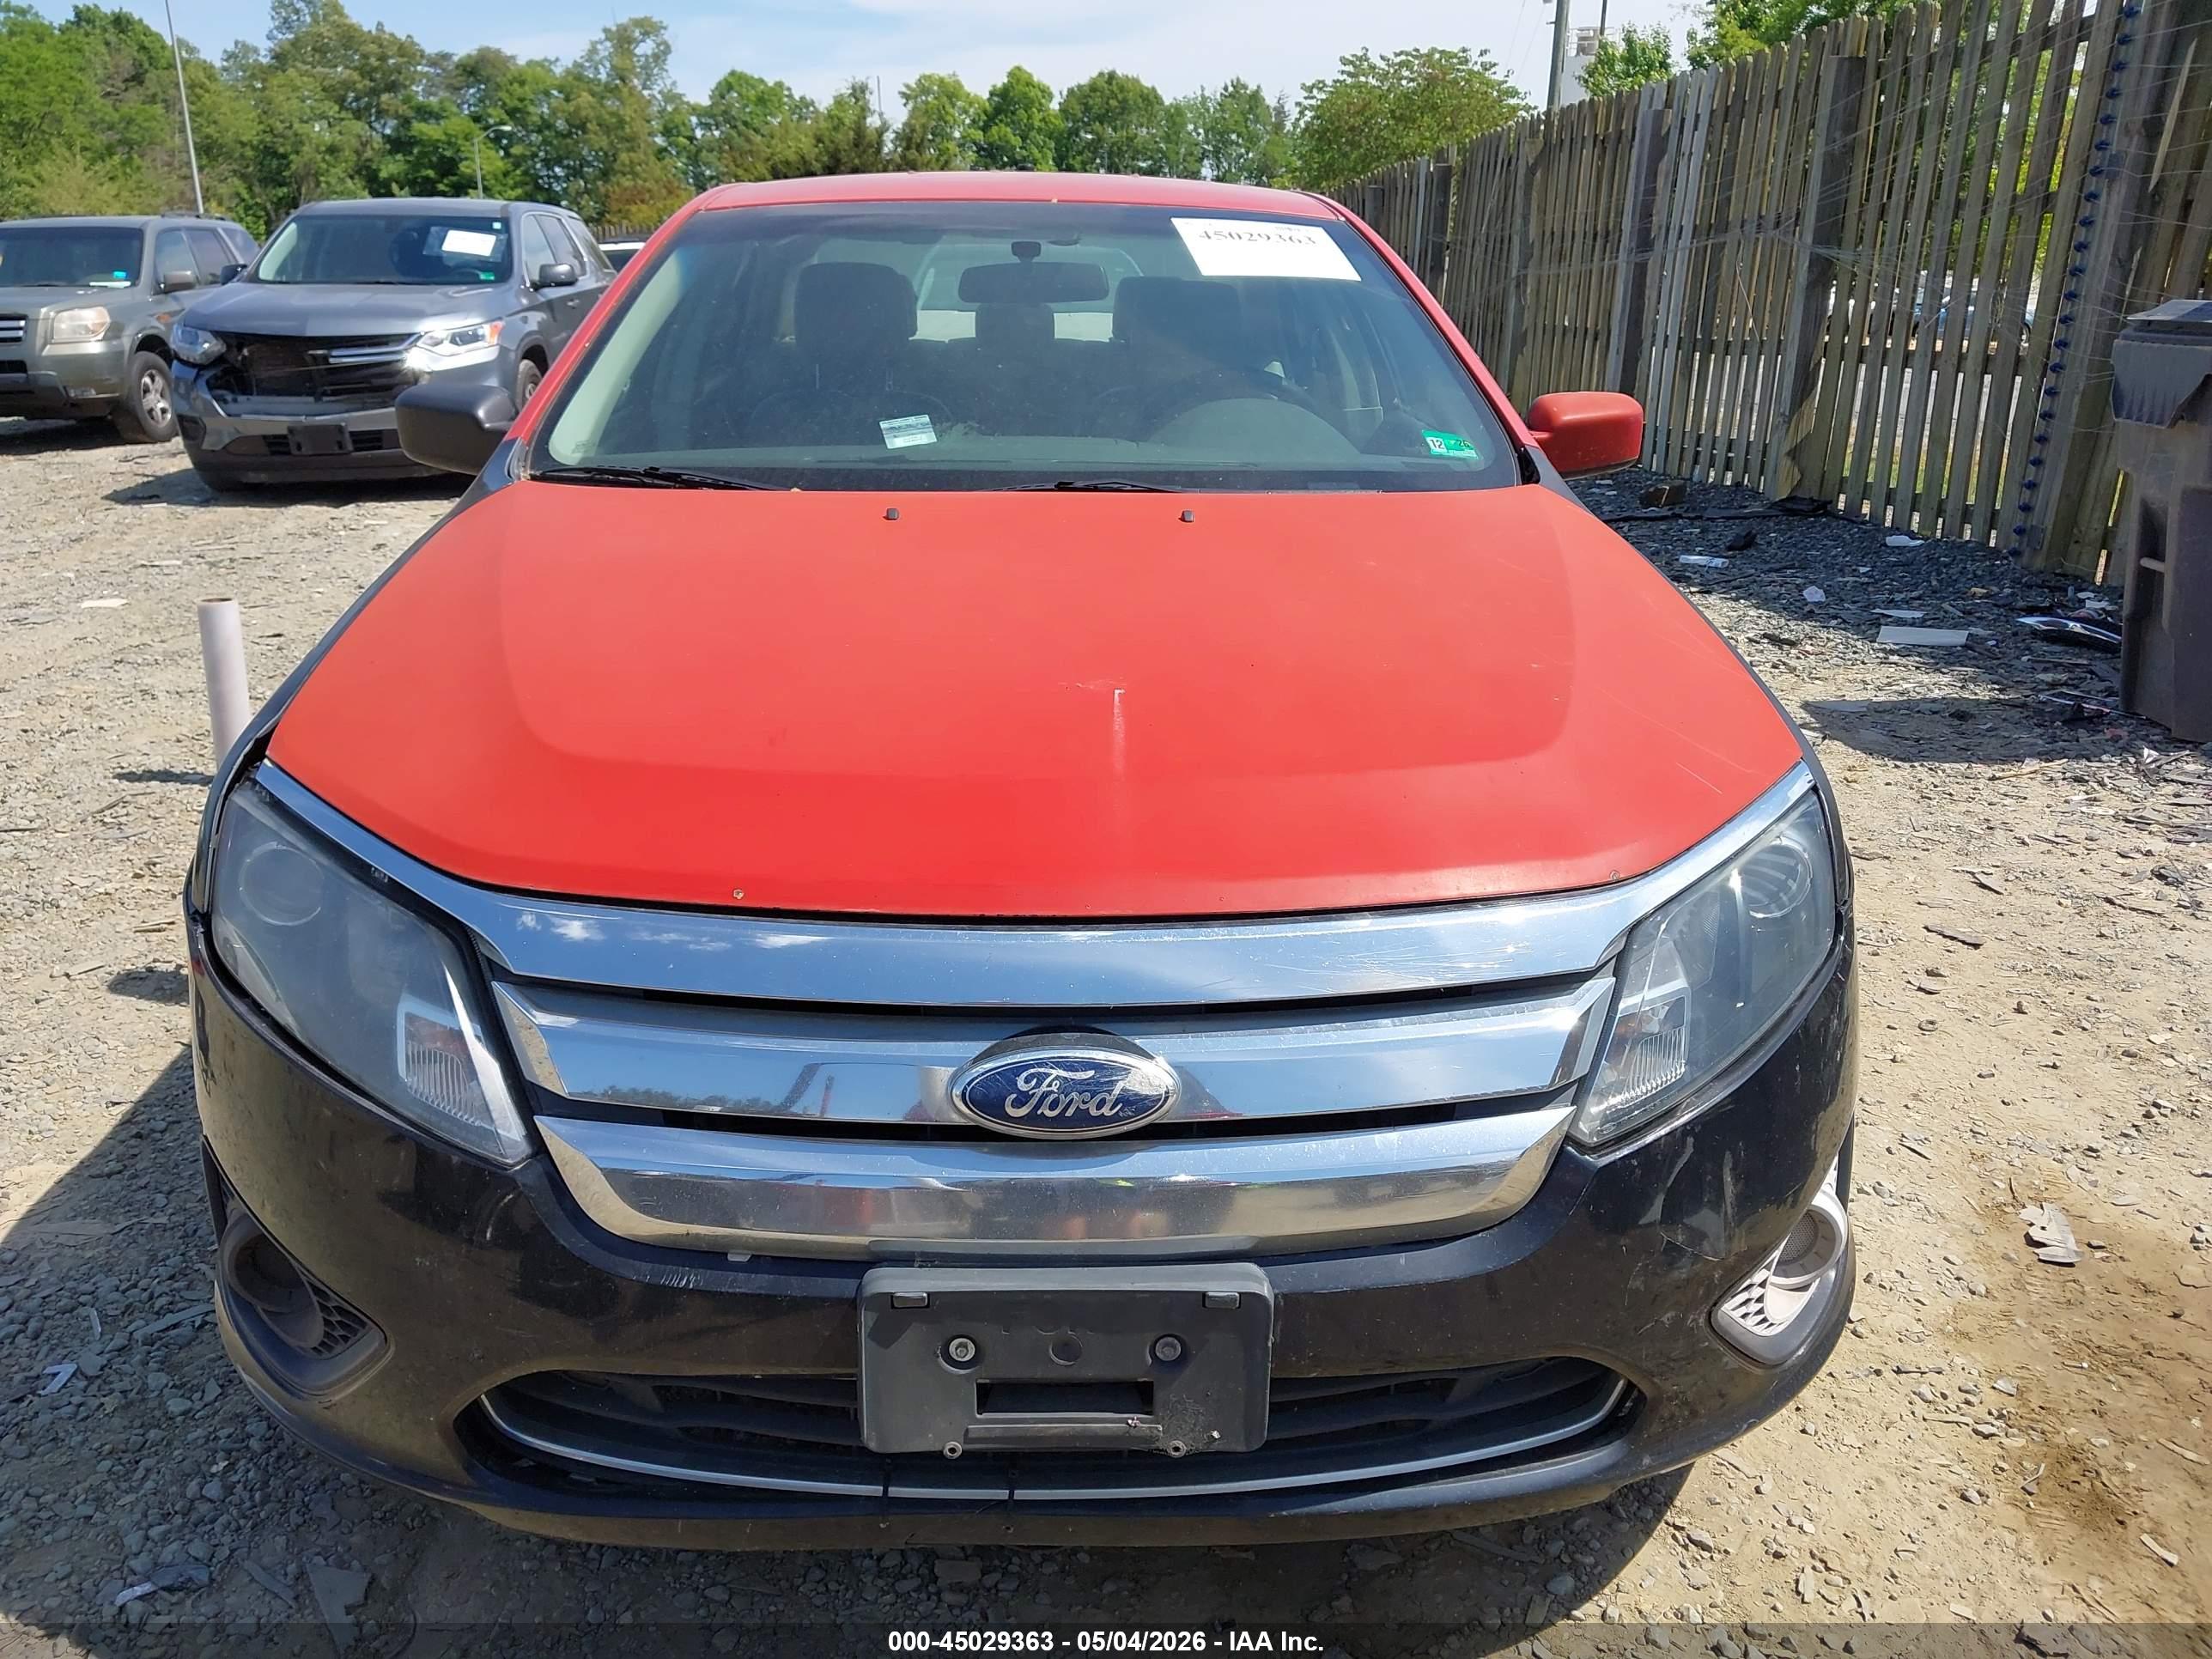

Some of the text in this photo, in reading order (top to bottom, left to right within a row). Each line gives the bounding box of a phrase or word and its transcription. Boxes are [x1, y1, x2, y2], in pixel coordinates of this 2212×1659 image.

[1199, 230, 1316, 246] 45029363
[1429, 439, 1445, 450] 12
[1004, 1067, 1122, 1118] Ford
